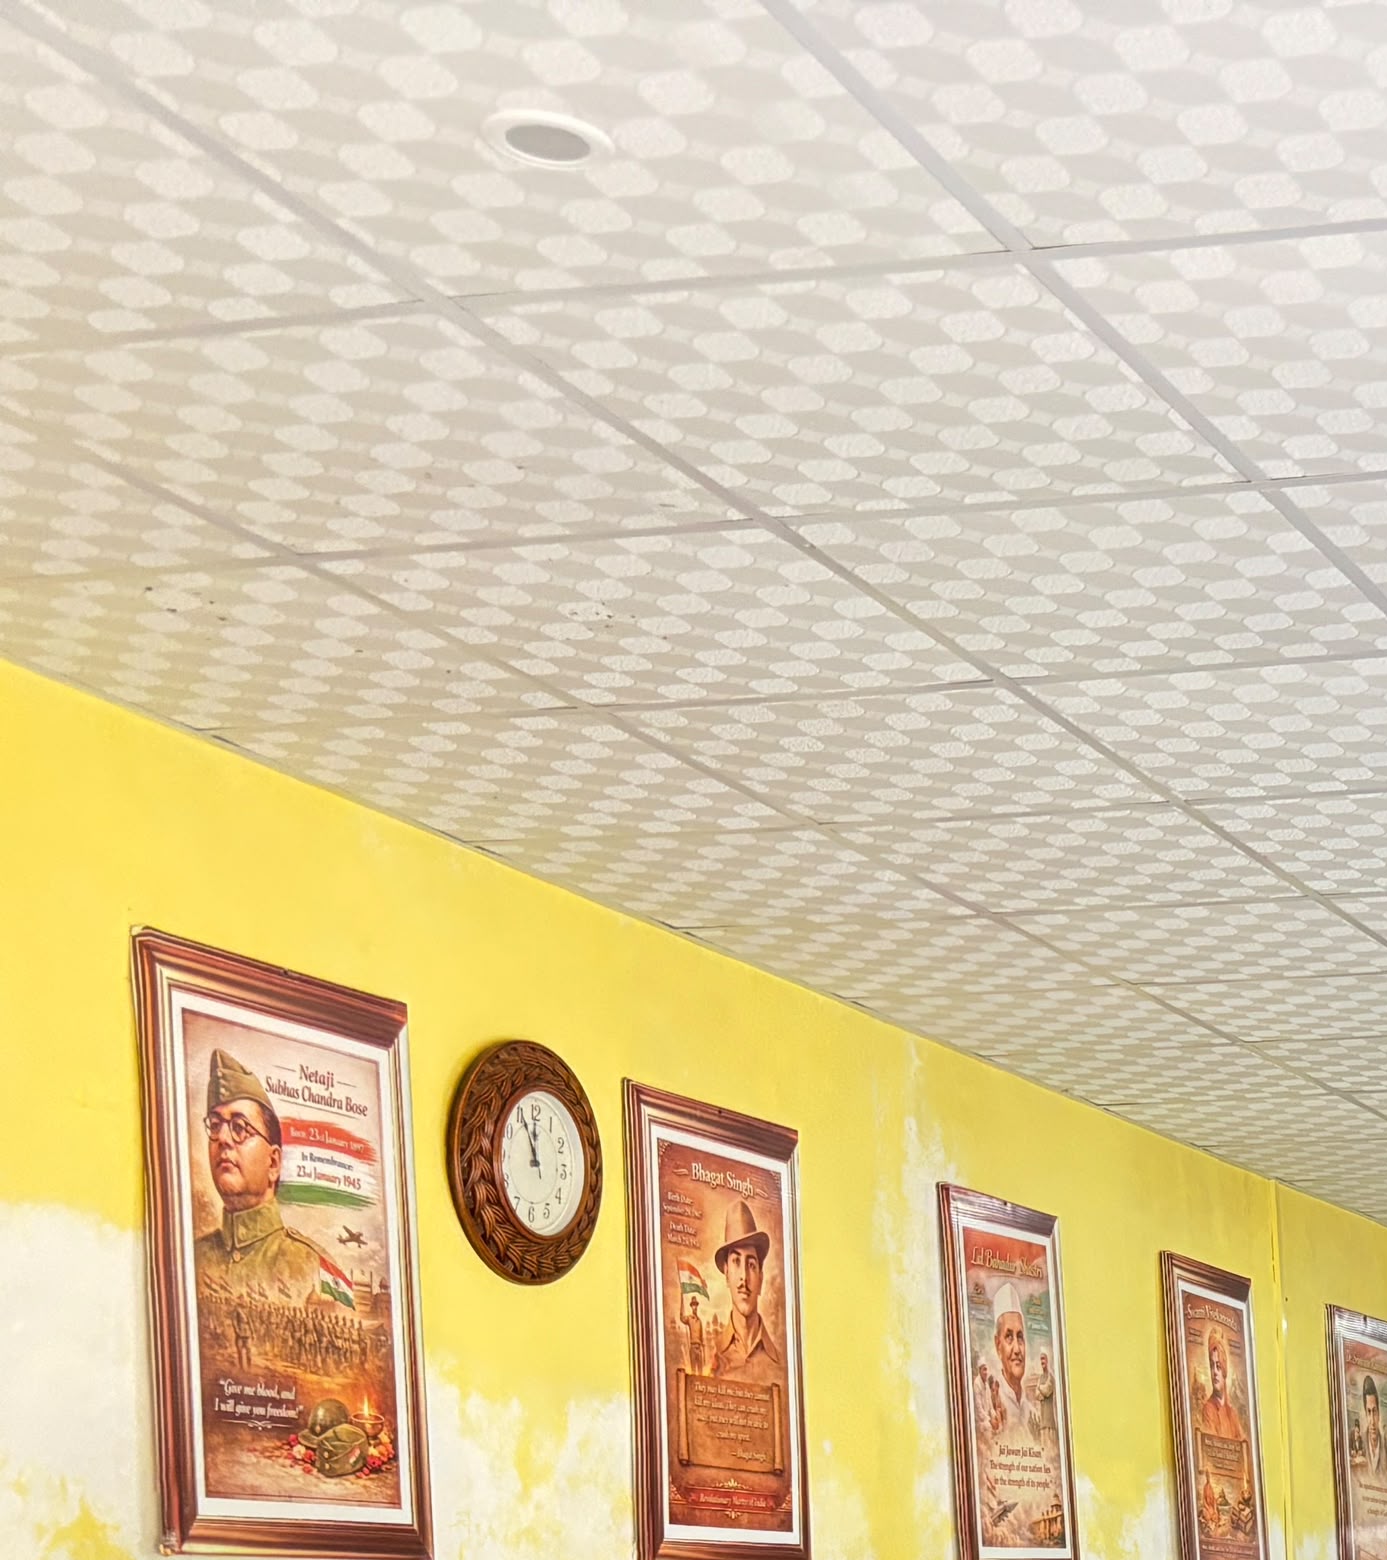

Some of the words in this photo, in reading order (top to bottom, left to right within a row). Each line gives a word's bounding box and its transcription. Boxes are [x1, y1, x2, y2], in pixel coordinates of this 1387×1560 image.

[299, 1064, 334, 1090] Netaji
[265, 1076, 300, 1100] Subhas
[301, 1085, 343, 1110] Chandra
[345, 1096, 368, 1117] Bose
[531, 1103, 541, 1121] 12
[557, 1137, 565, 1154] 2
[560, 1163, 567, 1180] 3
[691, 1162, 725, 1189] Bhagat
[726, 1171, 754, 1198] Singh
[555, 1187, 562, 1205] 4
[528, 1205, 535, 1223] 6
[543, 1202, 550, 1219] 5
[971, 1246, 984, 1265] Lal
